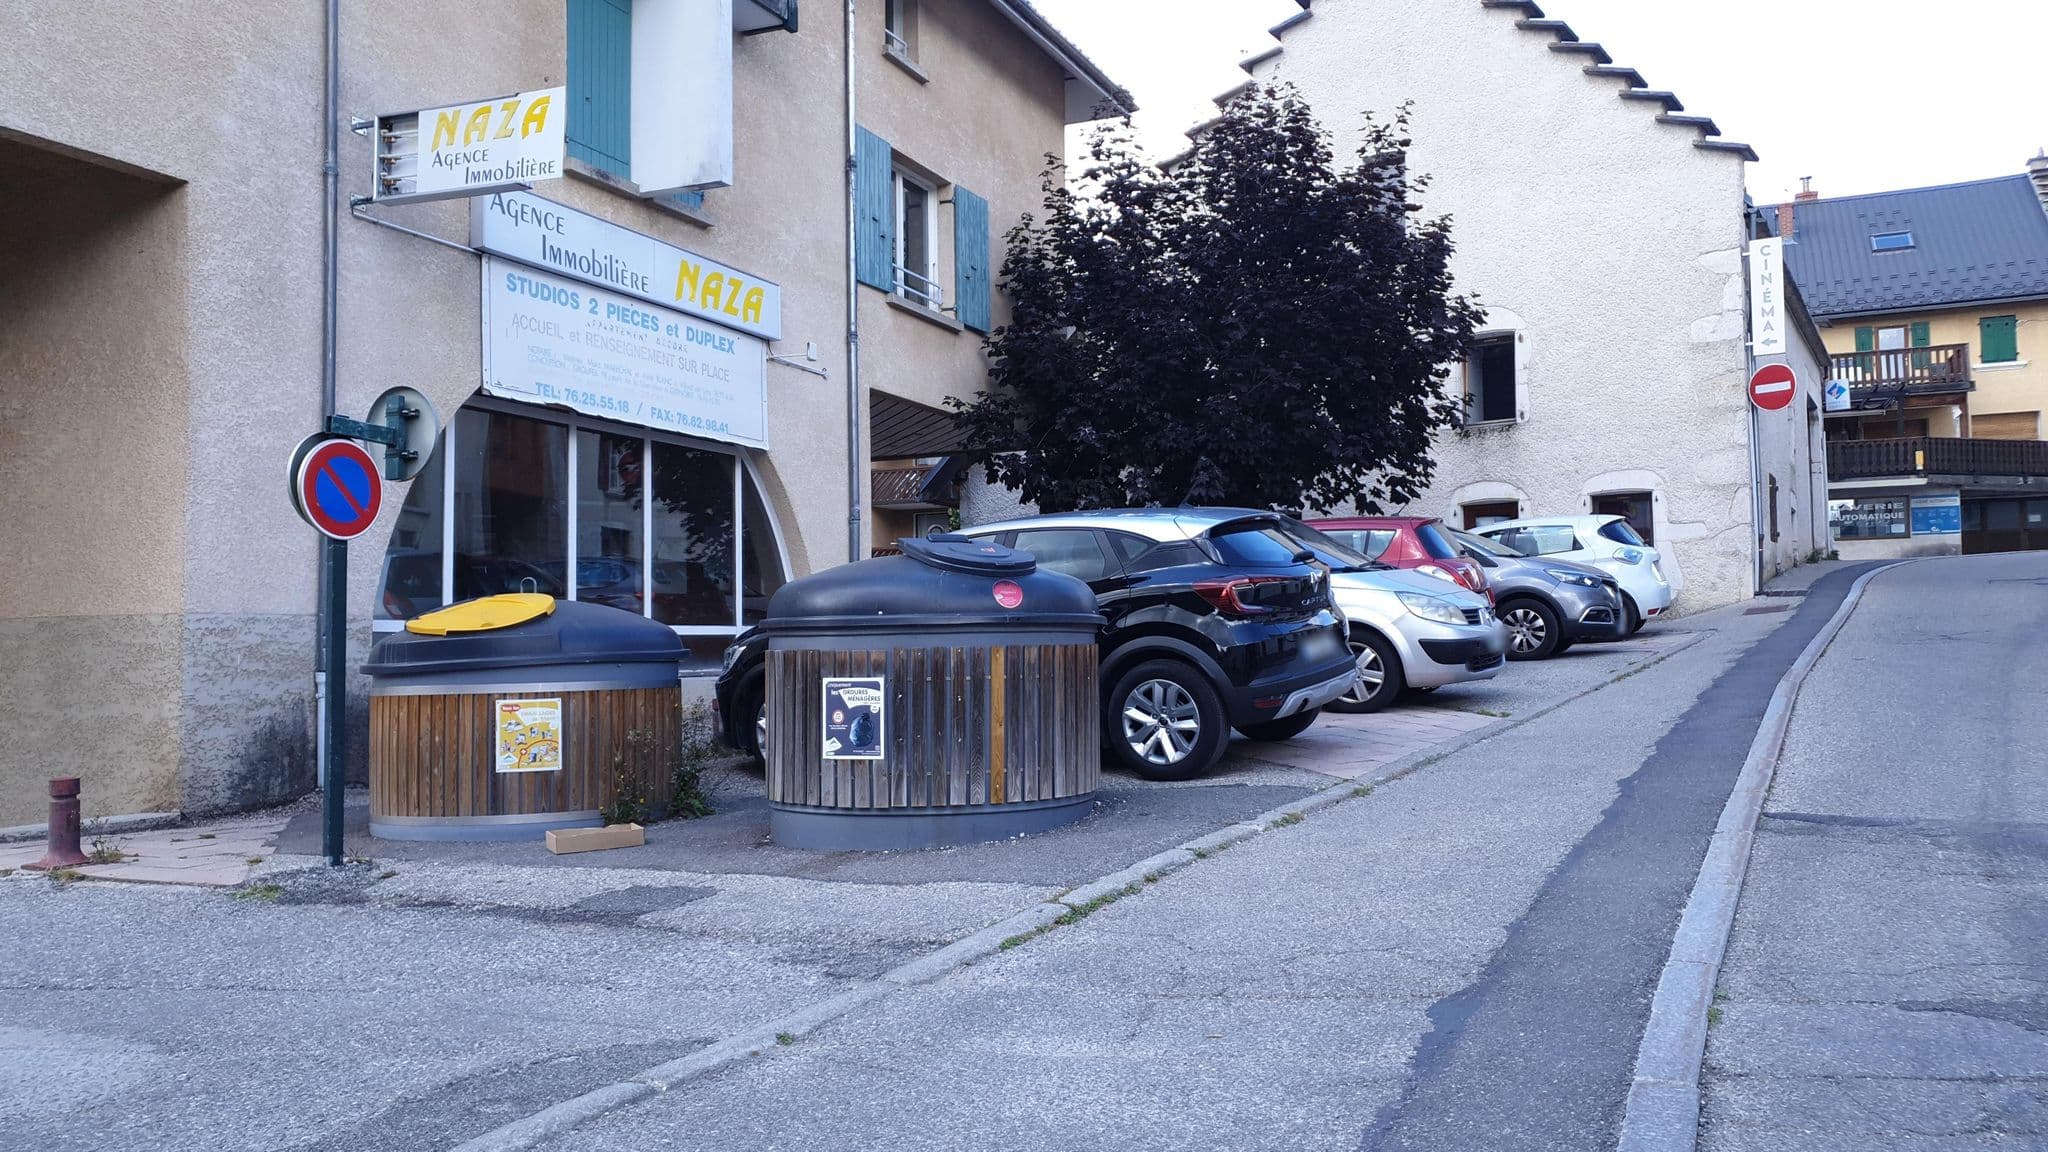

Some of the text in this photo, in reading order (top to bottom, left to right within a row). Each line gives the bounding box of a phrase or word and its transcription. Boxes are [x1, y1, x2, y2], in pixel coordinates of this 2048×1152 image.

[432, 95, 551, 152] NAZA
[506, 272, 735, 355] STUDIOS 2 PIECES et DUPLEX
[675, 259, 764, 325] NAZA
[1760, 245, 1774, 332] CINÉMA
[512, 313, 562, 338] ACCUEIL
[679, 356, 697, 374] SUR
[702, 362, 730, 383] PLACE
[651, 407, 674, 422] FAX:
[1830, 502, 1904, 511] LAVERIE
[1832, 512, 1904, 521] AUTOMATIQUE
